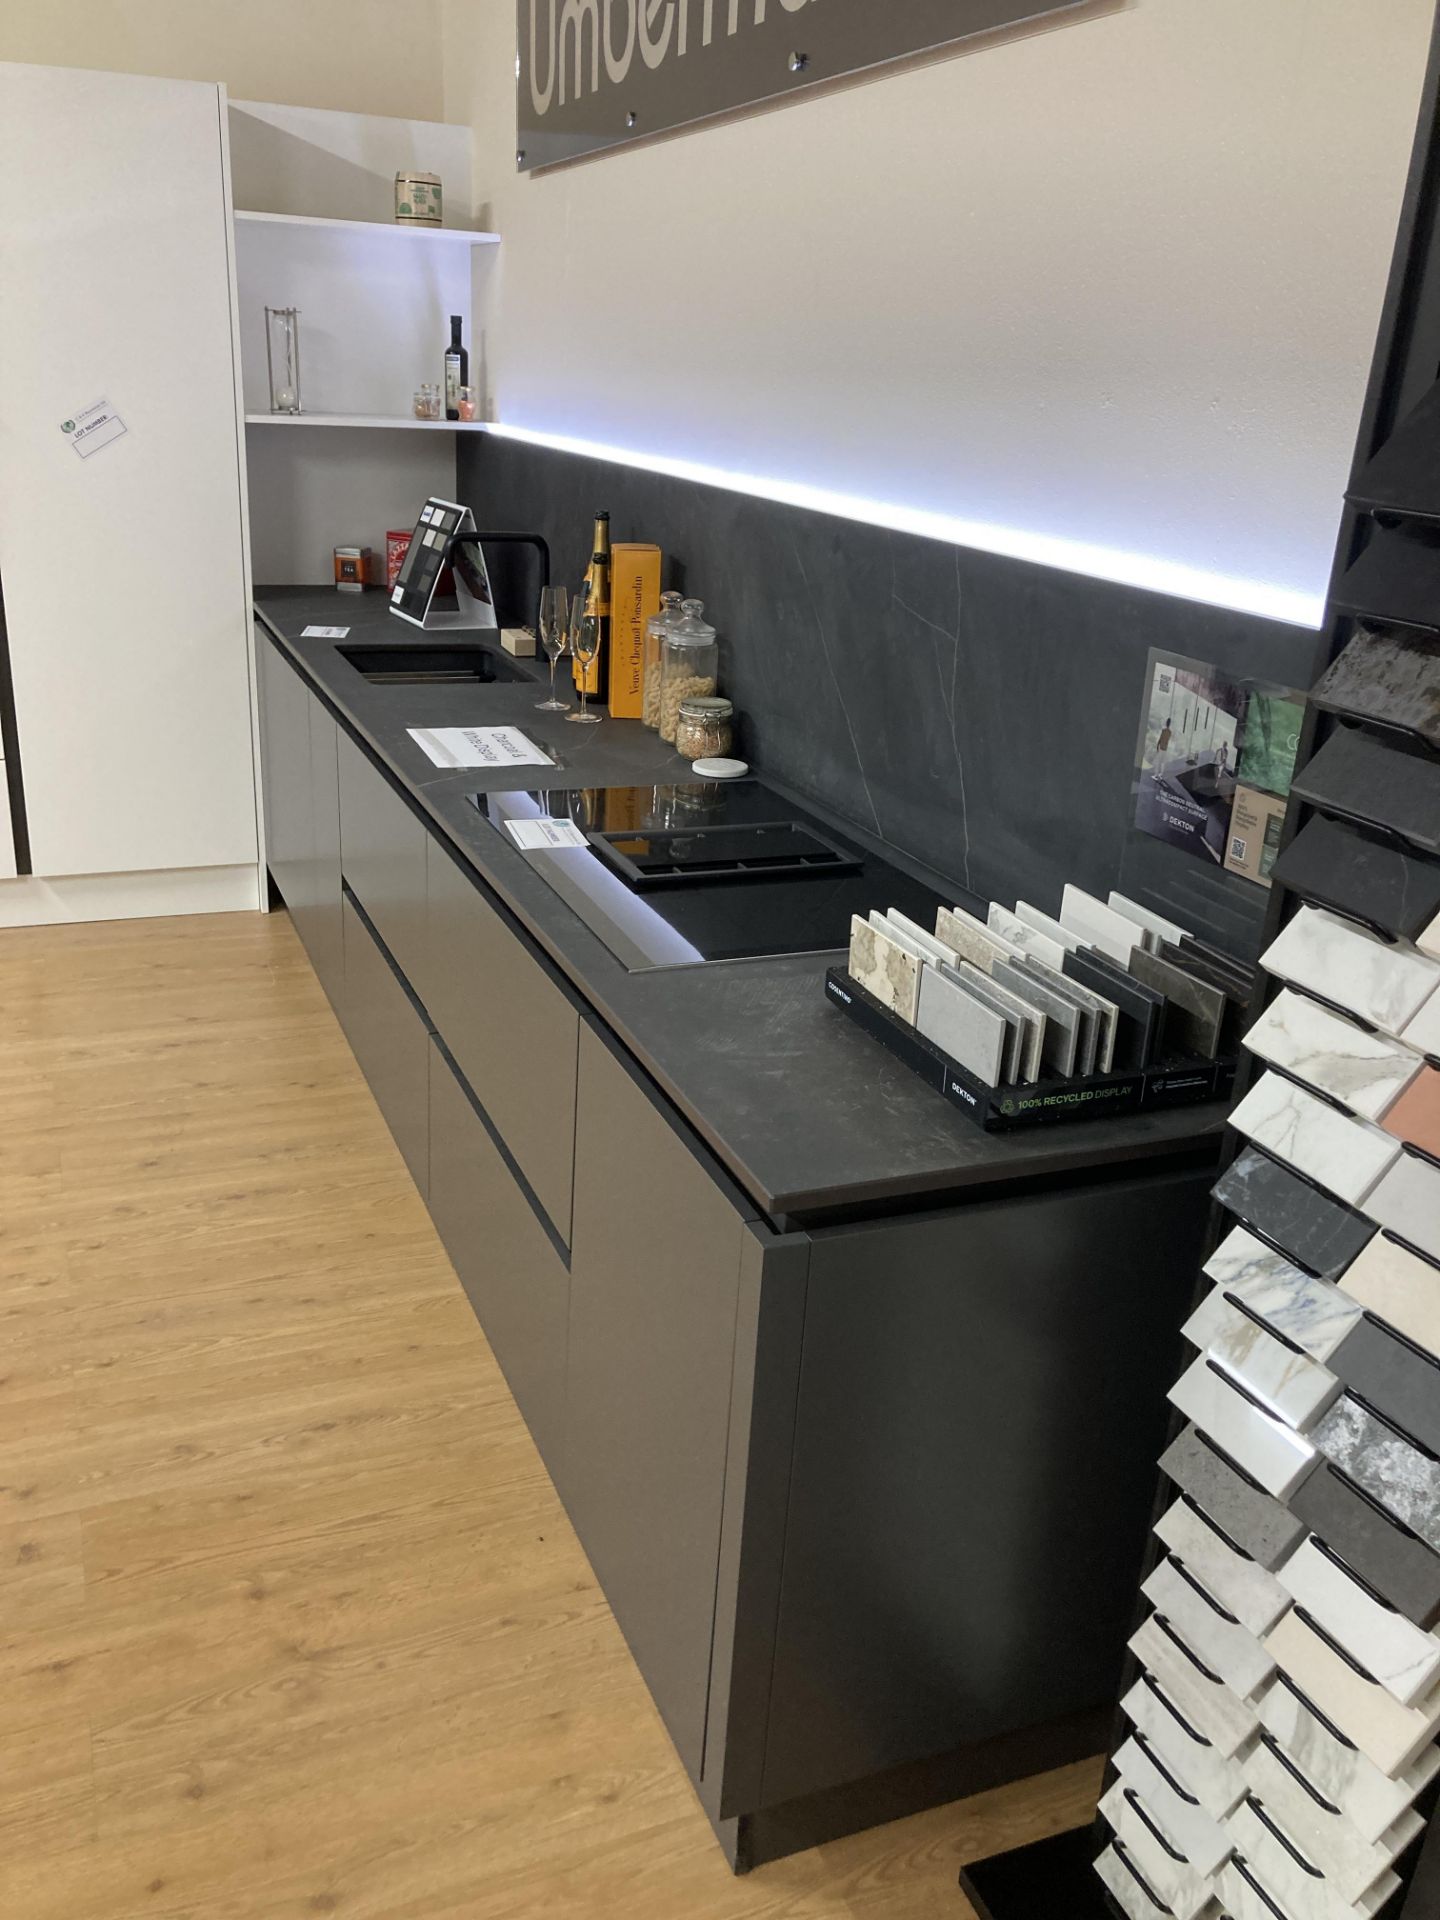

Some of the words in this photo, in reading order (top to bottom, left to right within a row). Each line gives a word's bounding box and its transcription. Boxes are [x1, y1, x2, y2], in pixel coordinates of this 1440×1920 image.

[529, 0, 817, 116] Umbe
[74, 428, 86, 439] LOT
[85, 414, 107, 431] NUMBER
[630, 576, 643, 623] Ponsardin
[1169, 815, 1195, 832] DEKTON
[828, 981, 852, 1004] COSENTINO
[952, 1082, 977, 1106] DEKTON
[1018, 1098, 1042, 1110] 100%
[1043, 1091, 1094, 1106] RECYCLED
[1094, 1086, 1133, 1099] DISPLAY
